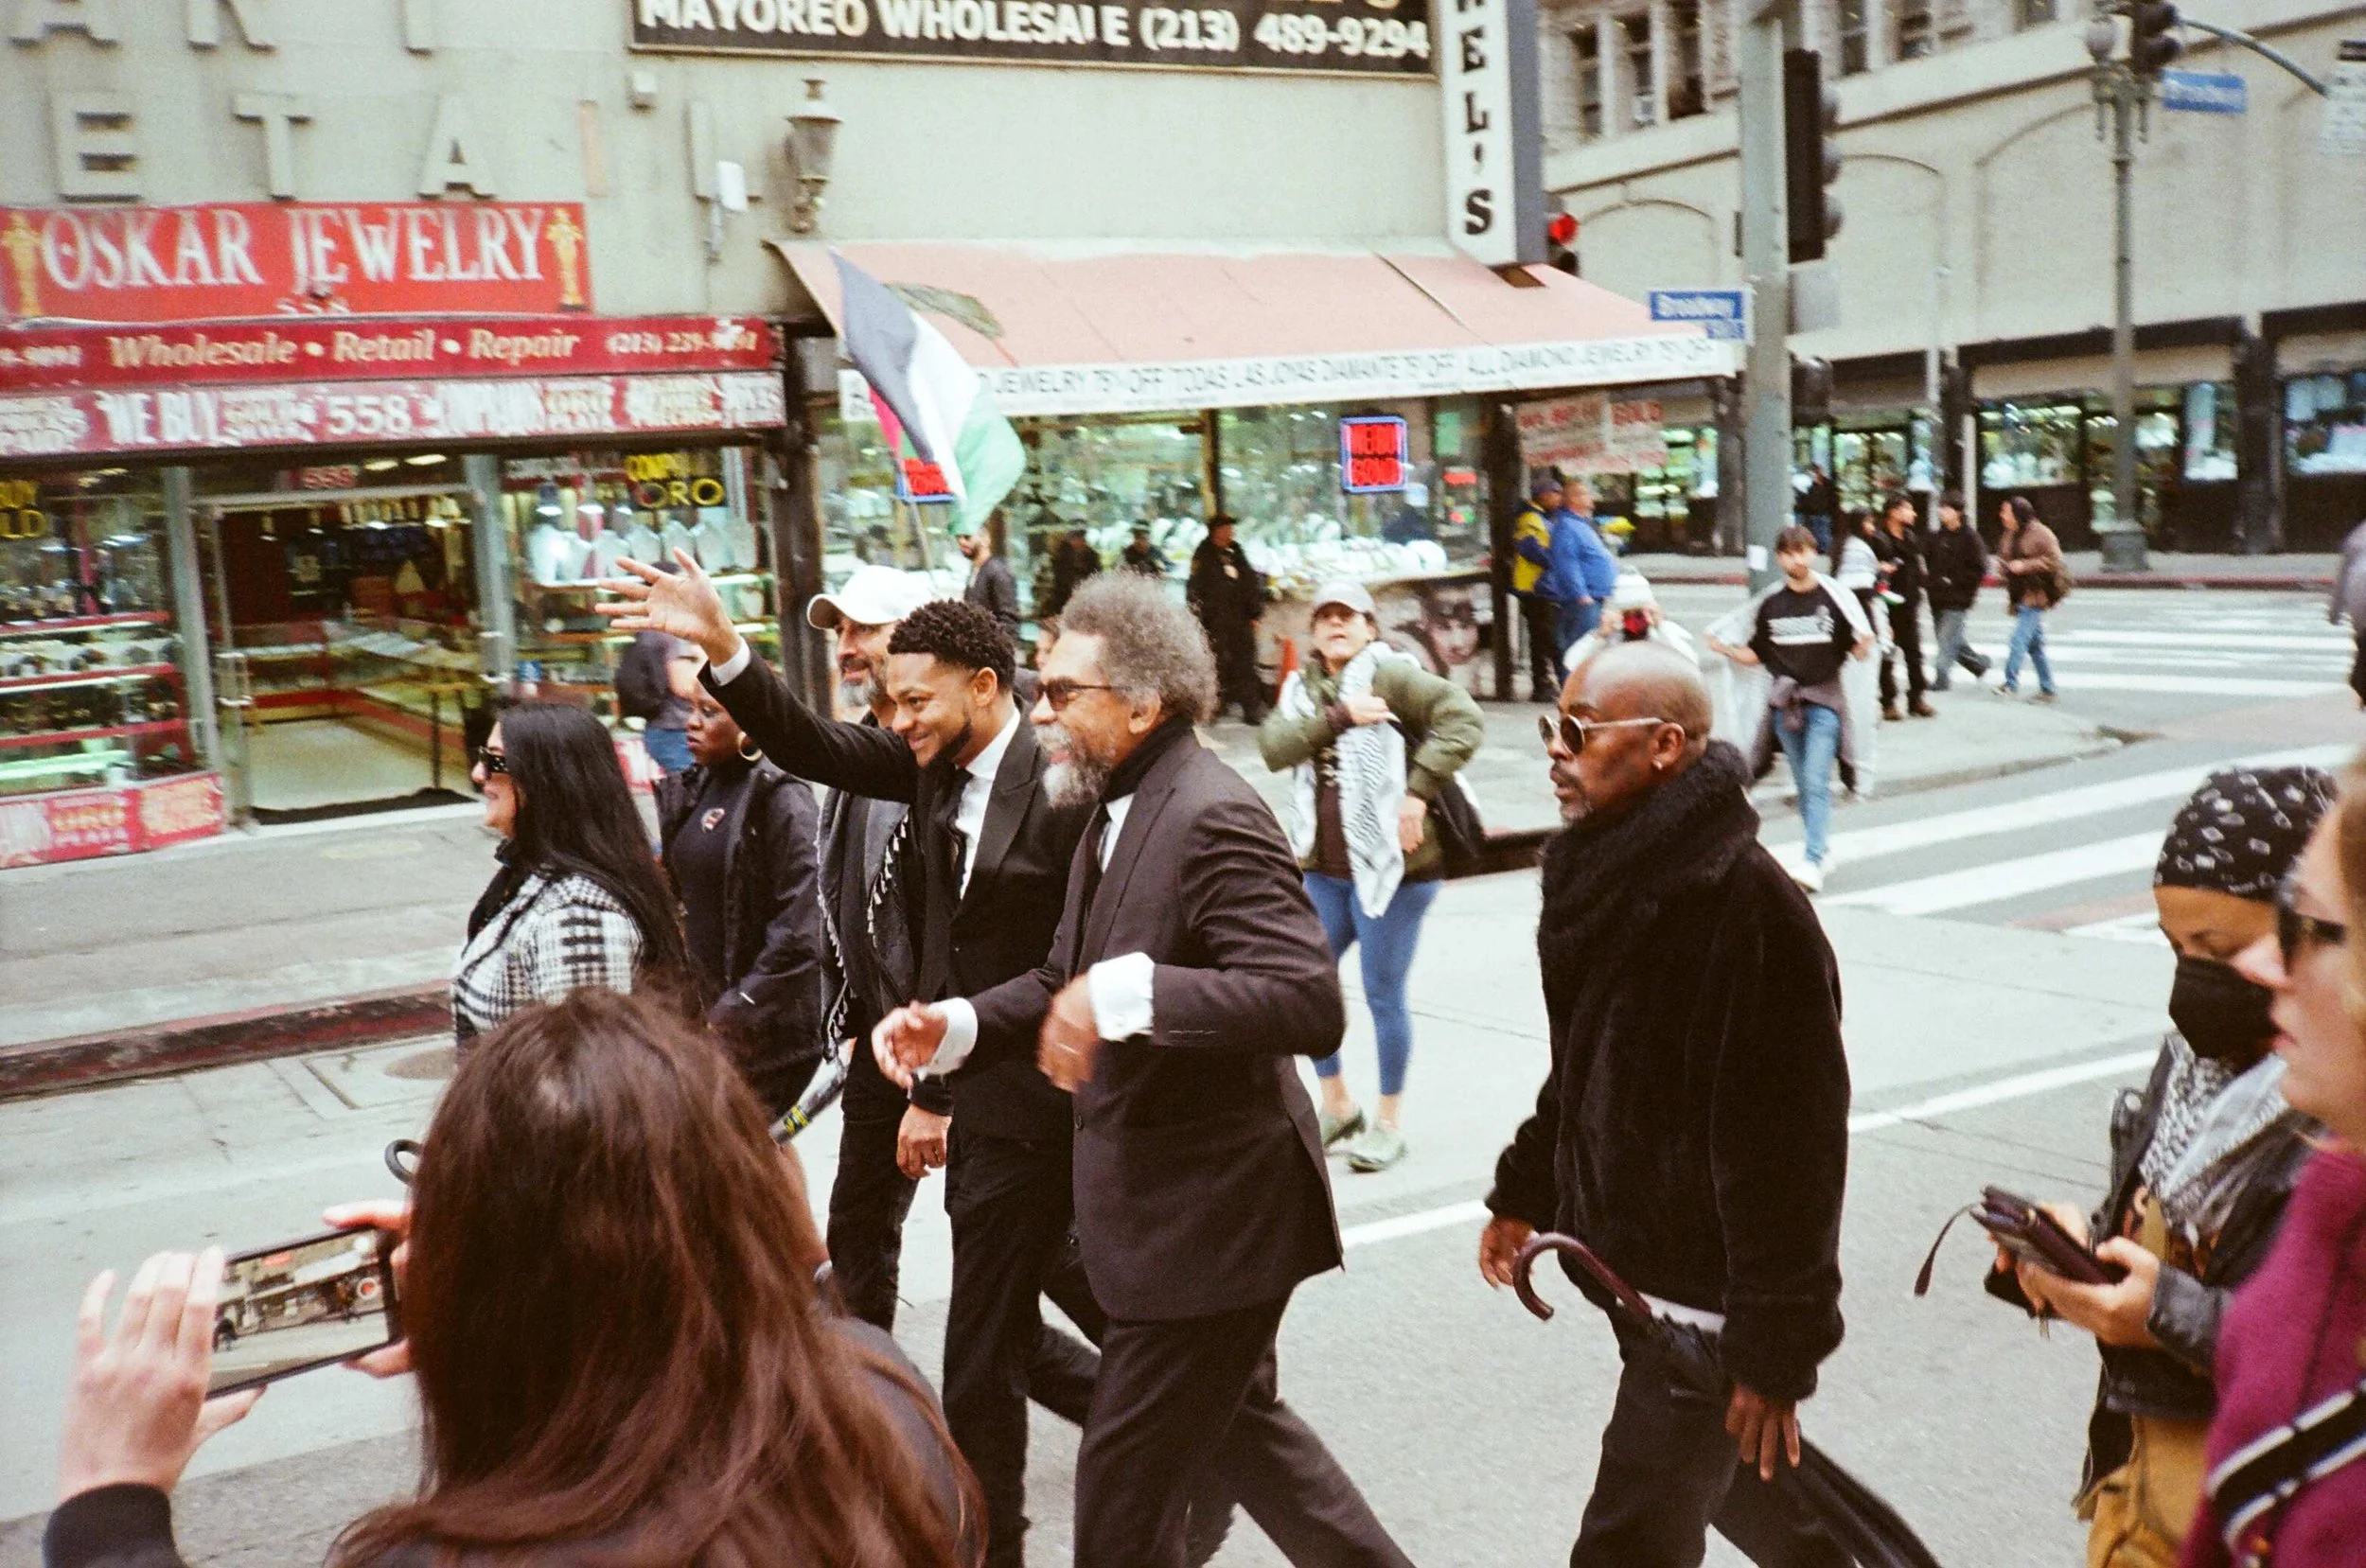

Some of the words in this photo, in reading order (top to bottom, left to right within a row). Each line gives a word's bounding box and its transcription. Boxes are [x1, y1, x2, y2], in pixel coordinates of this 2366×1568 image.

[639, 0, 869, 36] MAYOREO
[1139, 8, 1240, 51] (213)
[1254, 13, 1431, 58] 489-9294
[41, 209, 265, 291] OSKAR
[286, 207, 547, 295] JEWELRY
[106, 333, 298, 368] Wholesale
[333, 329, 436, 363] Retail
[469, 327, 580, 365] Repair
[325, 392, 413, 436] 558
[635, 478, 725, 508] ORO
